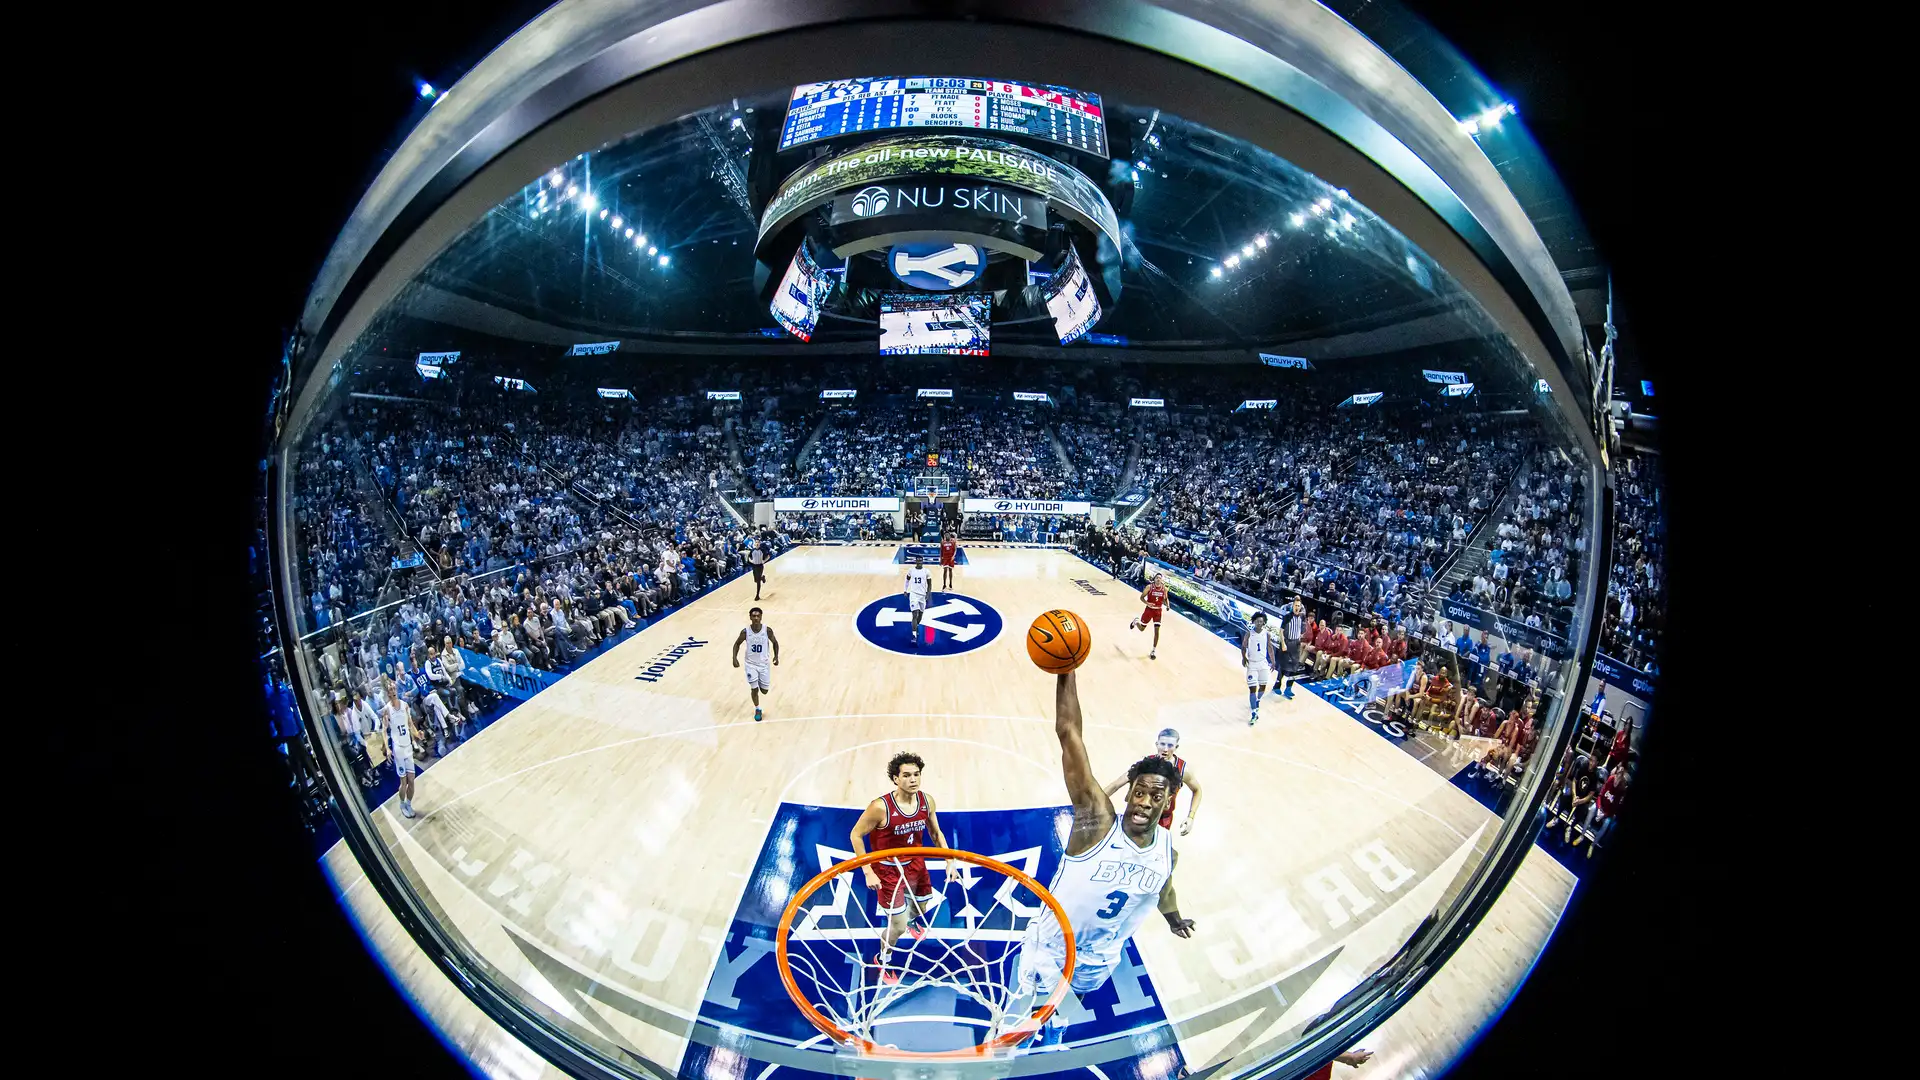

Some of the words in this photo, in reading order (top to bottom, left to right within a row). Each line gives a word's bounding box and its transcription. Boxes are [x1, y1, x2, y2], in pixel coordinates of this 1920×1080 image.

[929, 79, 965, 88] 16:03
[1003, 85, 1012, 93] 6
[1001, 111, 1025, 120] THOMAS
[783, 172, 822, 200] team.
[827, 158, 860, 176] The
[866, 147, 949, 165] all-new
[955, 146, 1062, 184] PALISADE.
[897, 187, 944, 209] NU
[953, 187, 1022, 217] SKIN
[821, 500, 869, 508] HYUNDAI
[1015, 502, 1063, 511] HYUNDAI
[1448, 605, 1471, 620] aptive
[1494, 621, 1518, 636] aptive
[751, 644, 762, 652] 30
[1256, 643, 1260, 652] 1
[635, 636, 708, 683] Marriott
[638, 643, 676, 670] CENTER
[398, 725, 406, 736] 15
[894, 820, 926, 831] EASTERN
[907, 834, 914, 844] 4
[1090, 860, 1162, 894] BYU
[1096, 890, 1129, 919] 3
